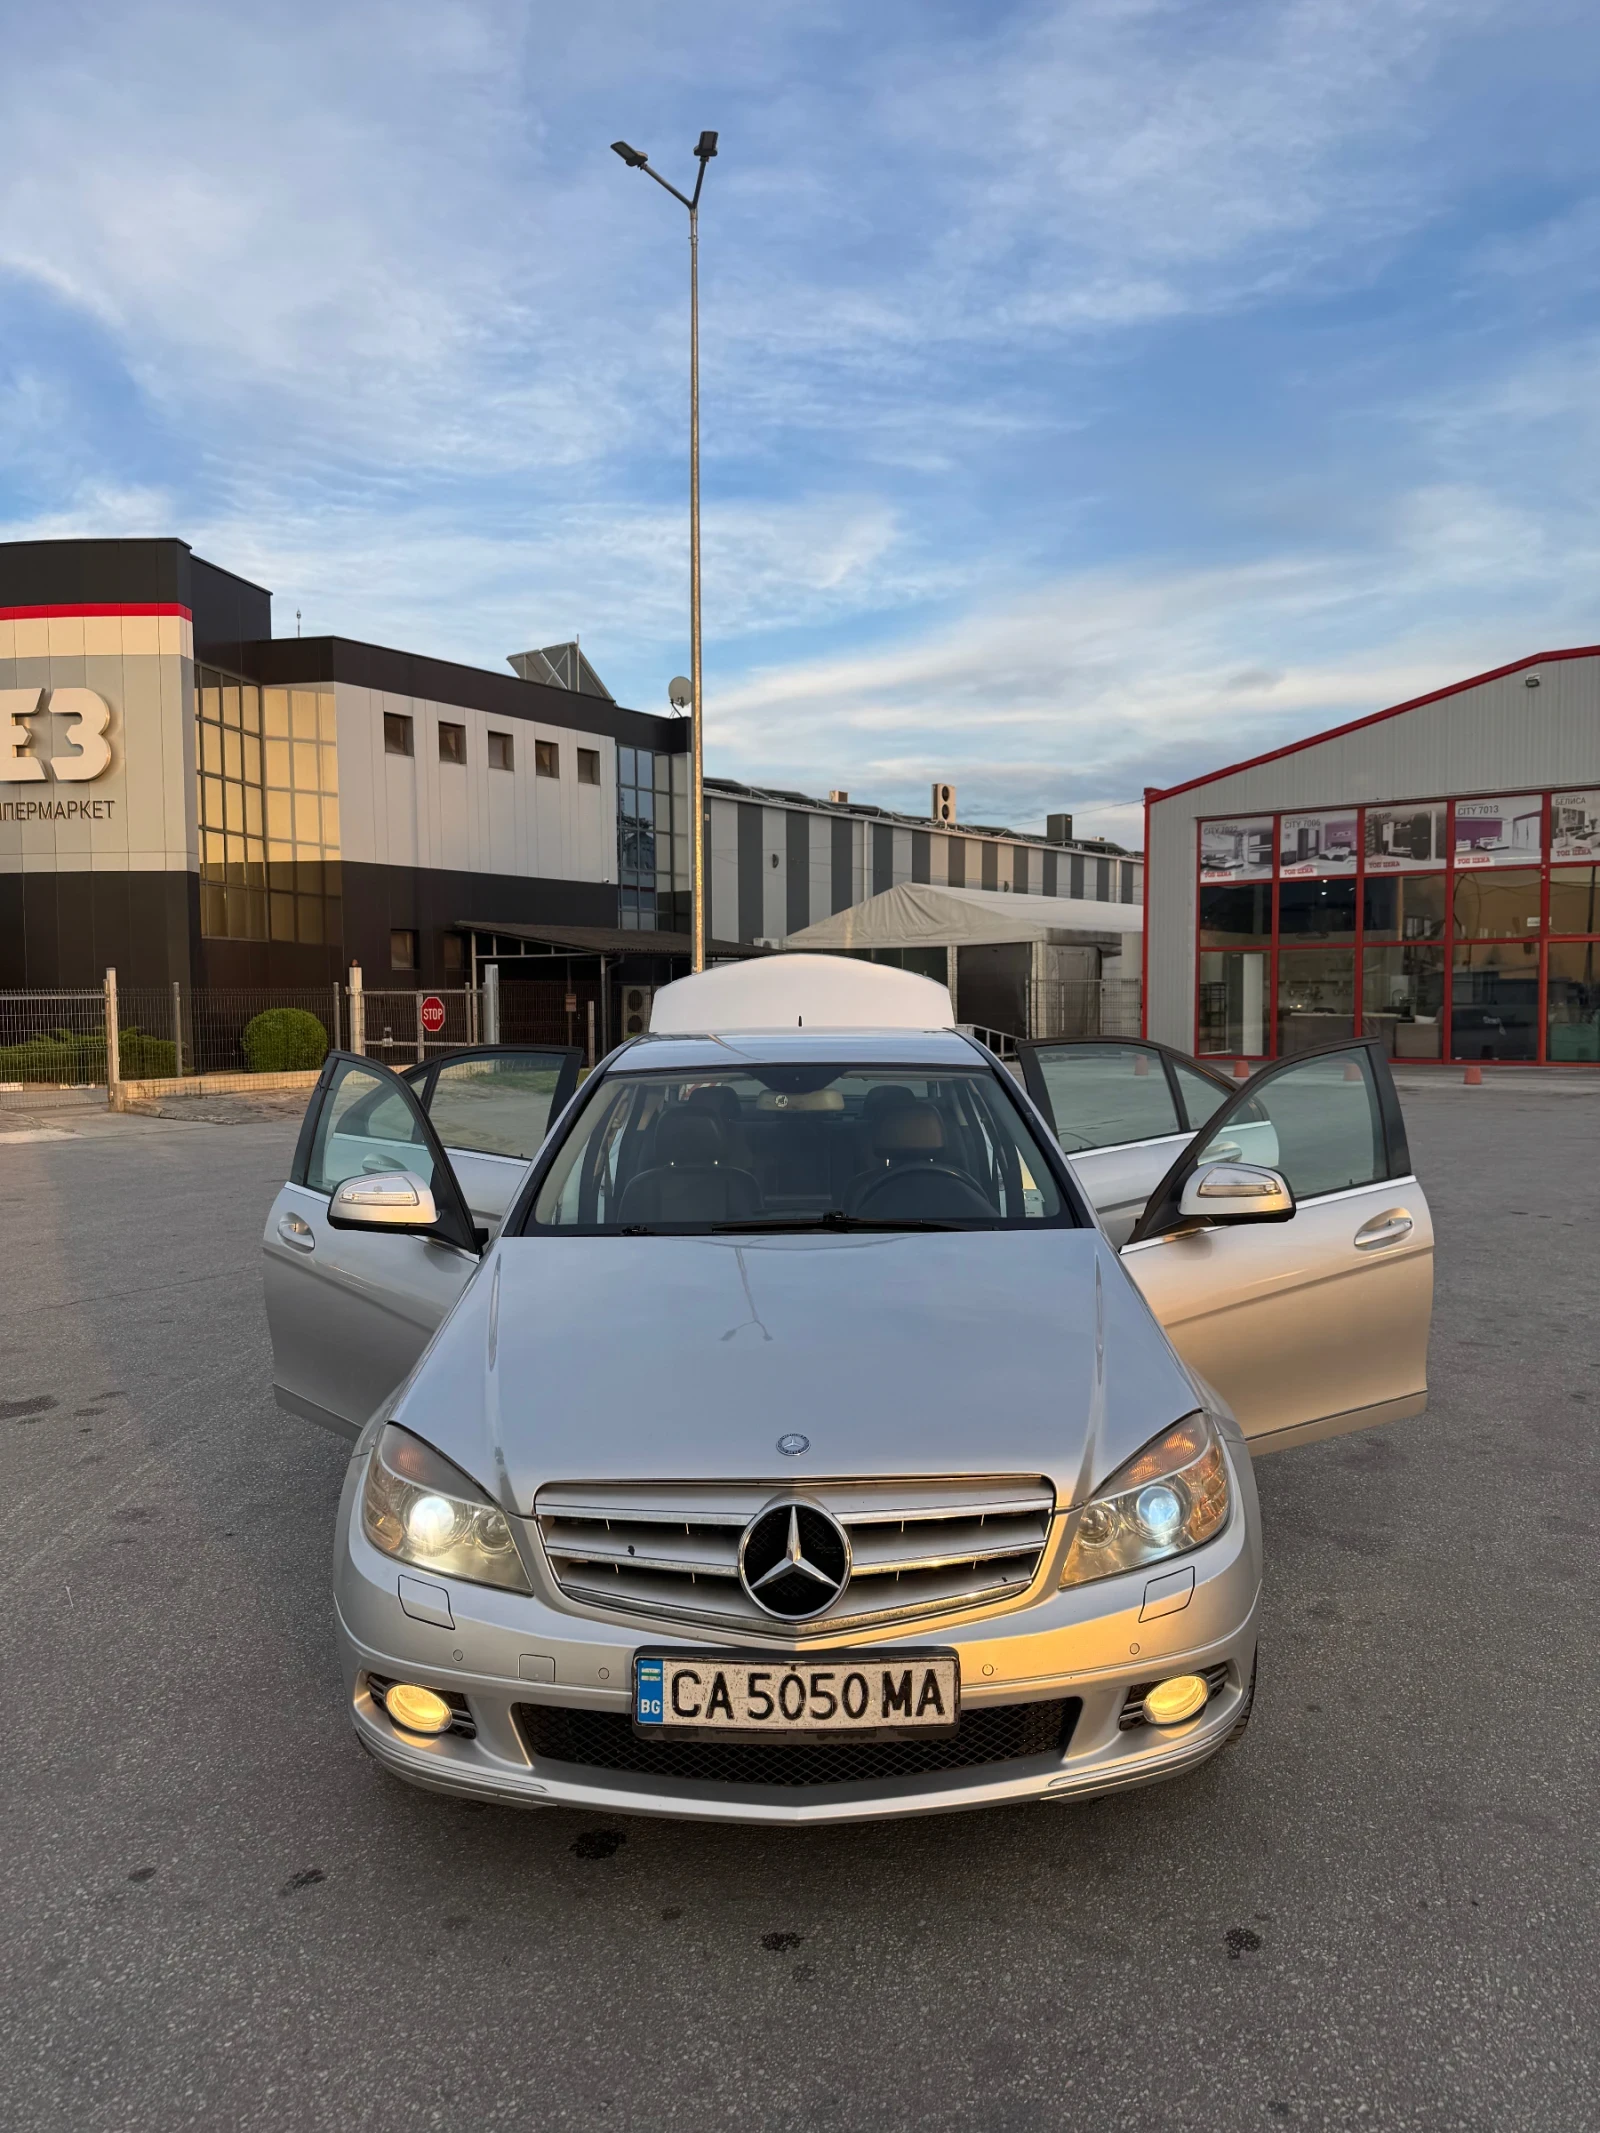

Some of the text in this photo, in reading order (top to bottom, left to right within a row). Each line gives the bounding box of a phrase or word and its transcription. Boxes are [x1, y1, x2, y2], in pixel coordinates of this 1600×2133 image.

[1555, 796, 1586, 806] БЕЛИСА
[0, 800, 115, 820] ПЕРМАРКЕТ
[1457, 806, 1477, 816] CITY
[1479, 804, 1499, 815] 7013
[1284, 820, 1301, 830] CITY
[1203, 827, 1220, 836] CITY
[423, 1008, 443, 1020] STOP
[671, 1668, 946, 1721] CA 5050 MA
[641, 1698, 662, 1715] BG
